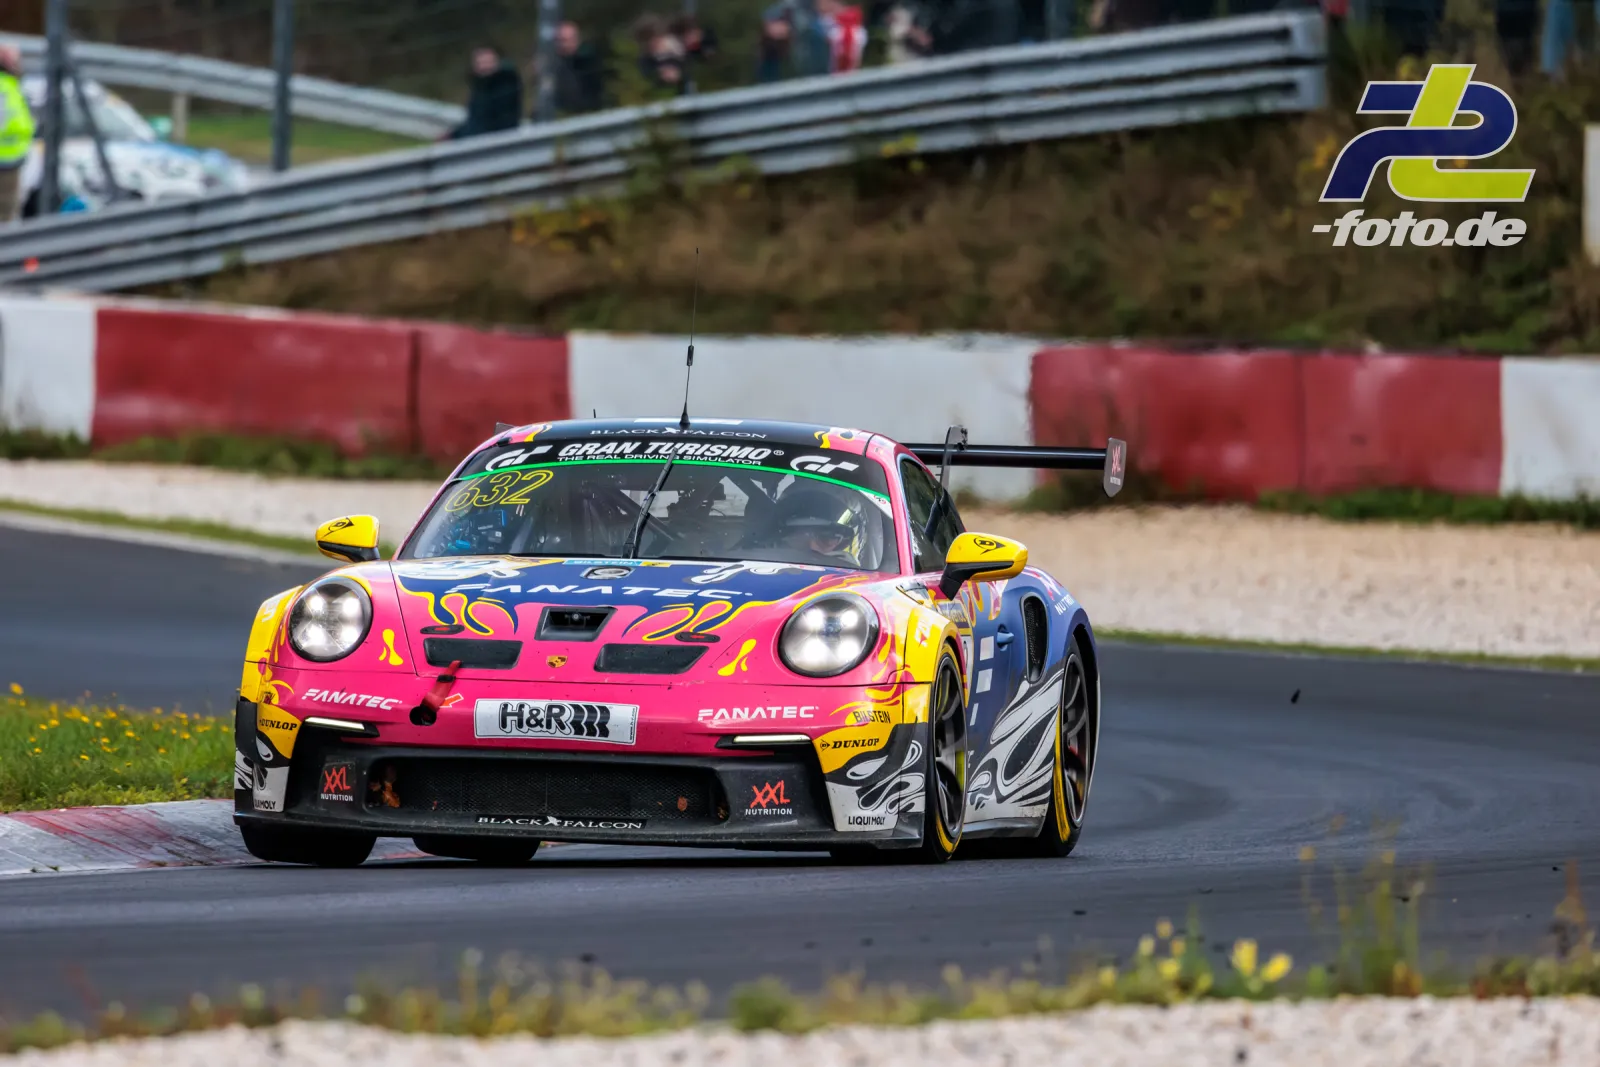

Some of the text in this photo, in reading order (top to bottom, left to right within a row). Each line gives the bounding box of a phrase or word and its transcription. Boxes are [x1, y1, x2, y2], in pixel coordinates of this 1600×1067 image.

[683, 429, 767, 439] FALCON
[558, 442, 642, 457] GRAN
[683, 455, 762, 466] SIMULATOR
[444, 469, 554, 512] 632
[445, 583, 744, 601] FANATEC
[301, 688, 398, 711] FANATEC
[500, 702, 571, 735] H&R
[697, 705, 815, 721] FANATEC
[853, 710, 891, 724] BILSTEIN
[260, 718, 298, 731] DUNLOP
[831, 737, 880, 749] DUNLOP
[323, 766, 351, 793] XXL
[320, 793, 353, 802] NUTRITION
[750, 780, 791, 808] XXL
[745, 808, 793, 816] NUTRITION
[477, 816, 643, 829] BLACK FALCON
[848, 815, 886, 826] LIQUI MOLY
